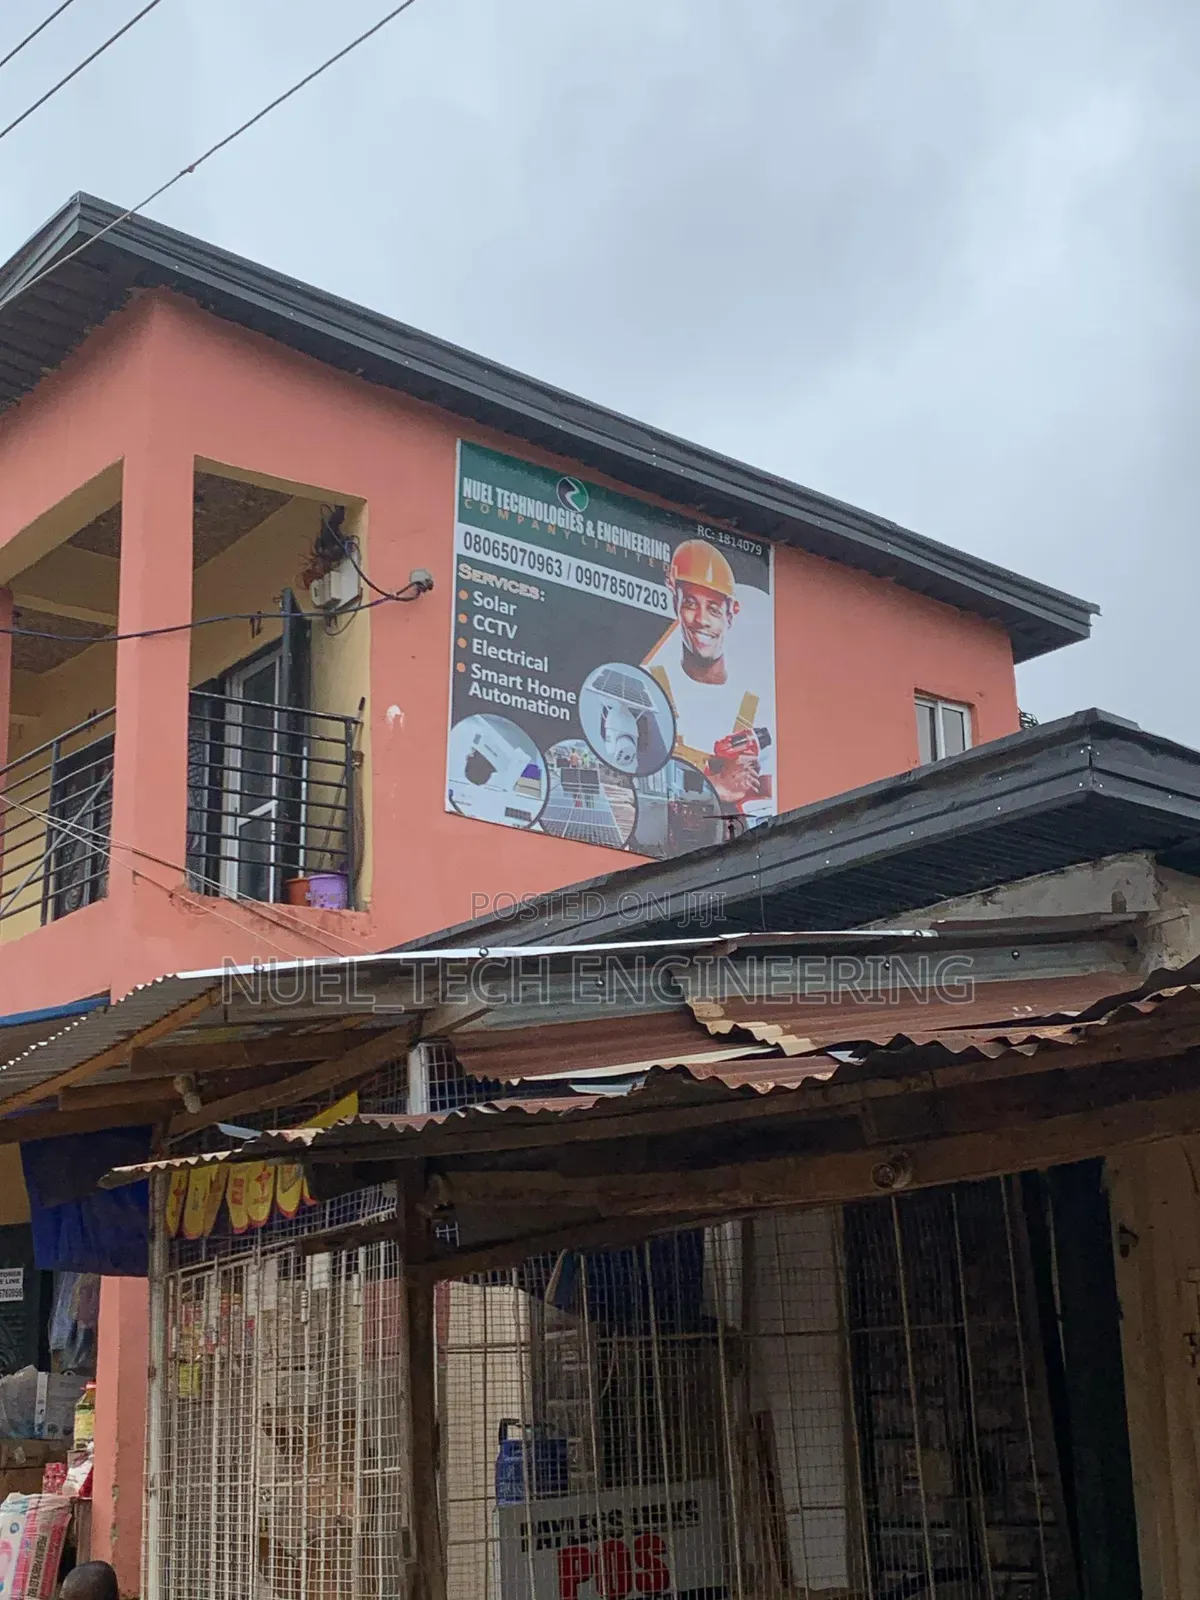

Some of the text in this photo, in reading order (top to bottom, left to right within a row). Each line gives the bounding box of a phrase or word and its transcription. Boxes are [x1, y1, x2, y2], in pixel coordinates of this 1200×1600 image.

[463, 477, 672, 563] NUEL TECHNOLOGIES & ENGINEERING
[463, 499, 672, 572] COMPANY LIMITED
[697, 524, 715, 540] RC:
[457, 562, 545, 602] SERVICES:
[463, 531, 563, 578] 08065070963
[575, 565, 668, 611] 09078507203
[472, 590, 518, 616] Solar
[472, 614, 518, 640] CCTV
[472, 637, 549, 673] Electrical
[468, 681, 571, 721] Automation
[471, 663, 577, 705] Smart Home
[556, 1530, 671, 1600] POS
